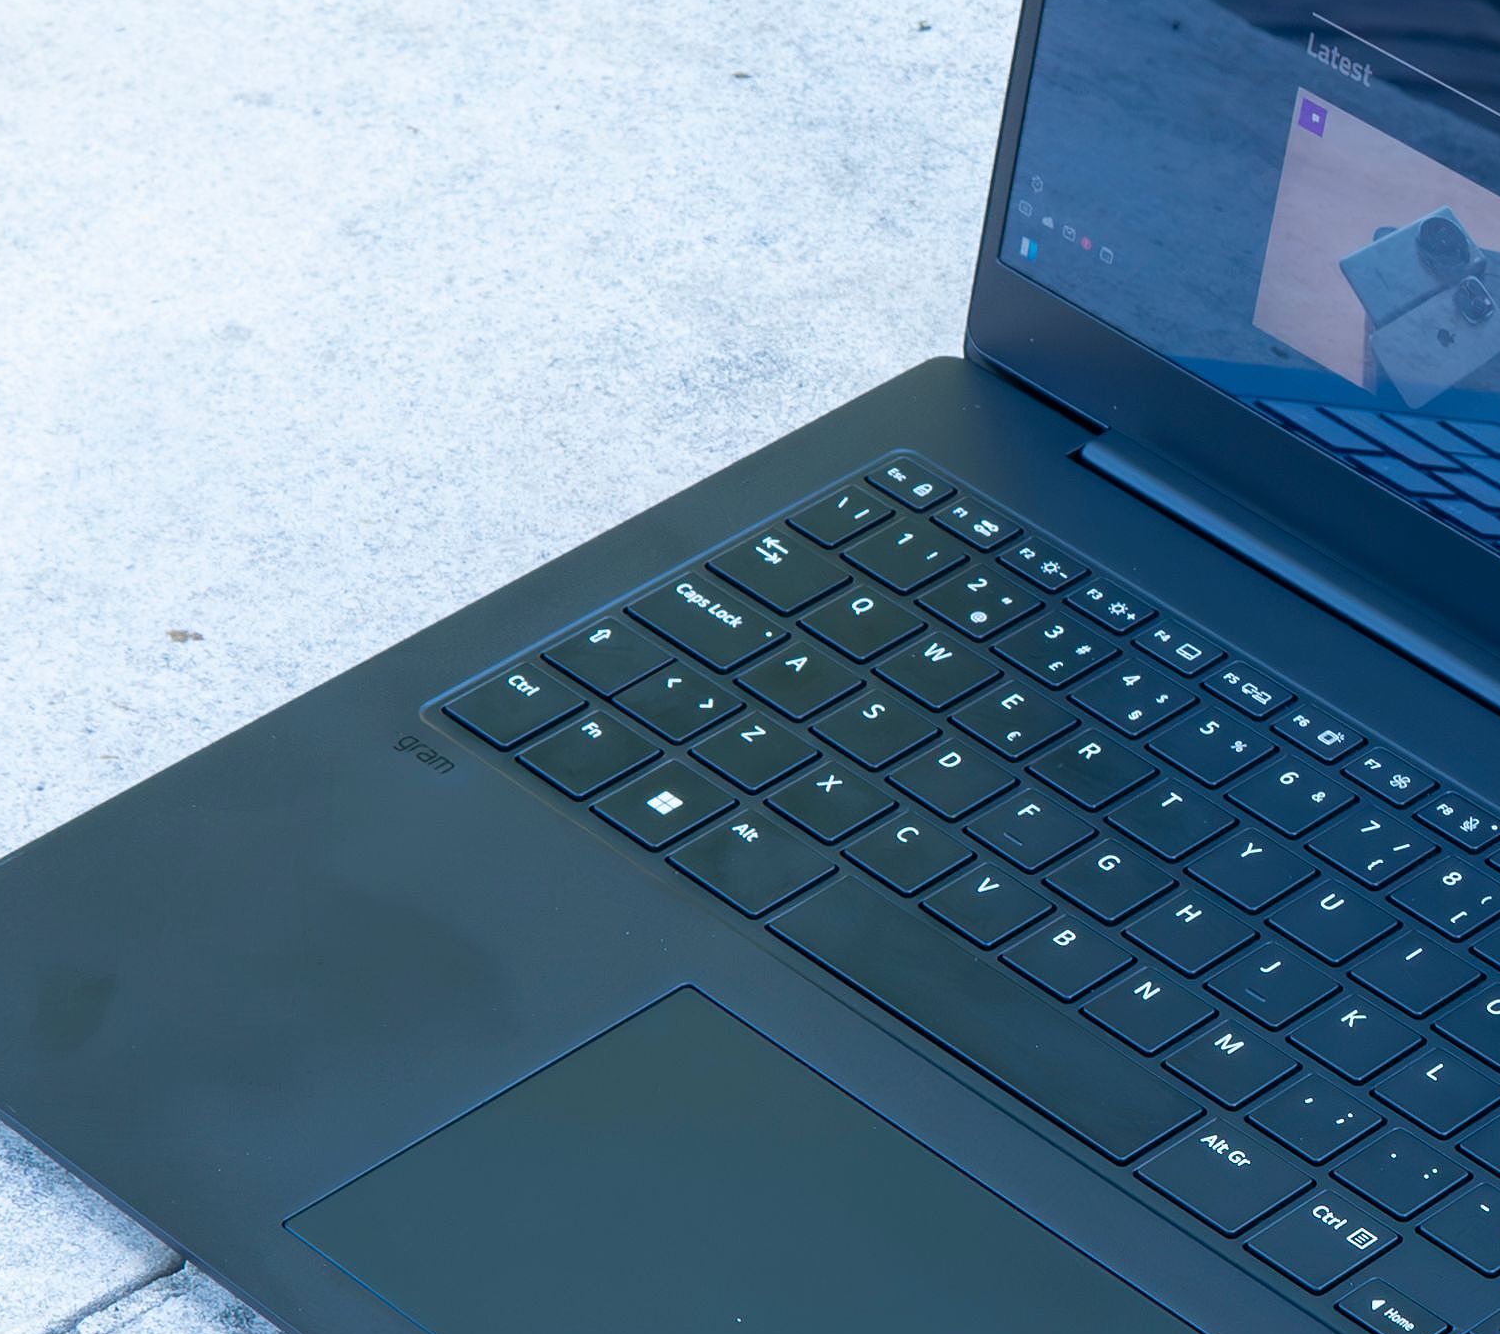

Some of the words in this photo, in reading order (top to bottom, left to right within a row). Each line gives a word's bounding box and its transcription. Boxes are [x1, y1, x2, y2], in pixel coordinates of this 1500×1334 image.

[1306, 31, 1373, 88] Latest
[888, 468, 906, 481] Esc
[677, 584, 710, 607] Caps
[708, 604, 742, 627] Lock
[509, 676, 540, 696] Ctrl
[582, 722, 602, 738] Fn
[394, 736, 455, 774] gram
[733, 824, 758, 842] Alt
[1201, 1135, 1229, 1154] Alt
[1228, 1151, 1250, 1166] Gr
[1313, 1206, 1347, 1230] Ctrl
[1384, 1308, 1414, 1331] Home
